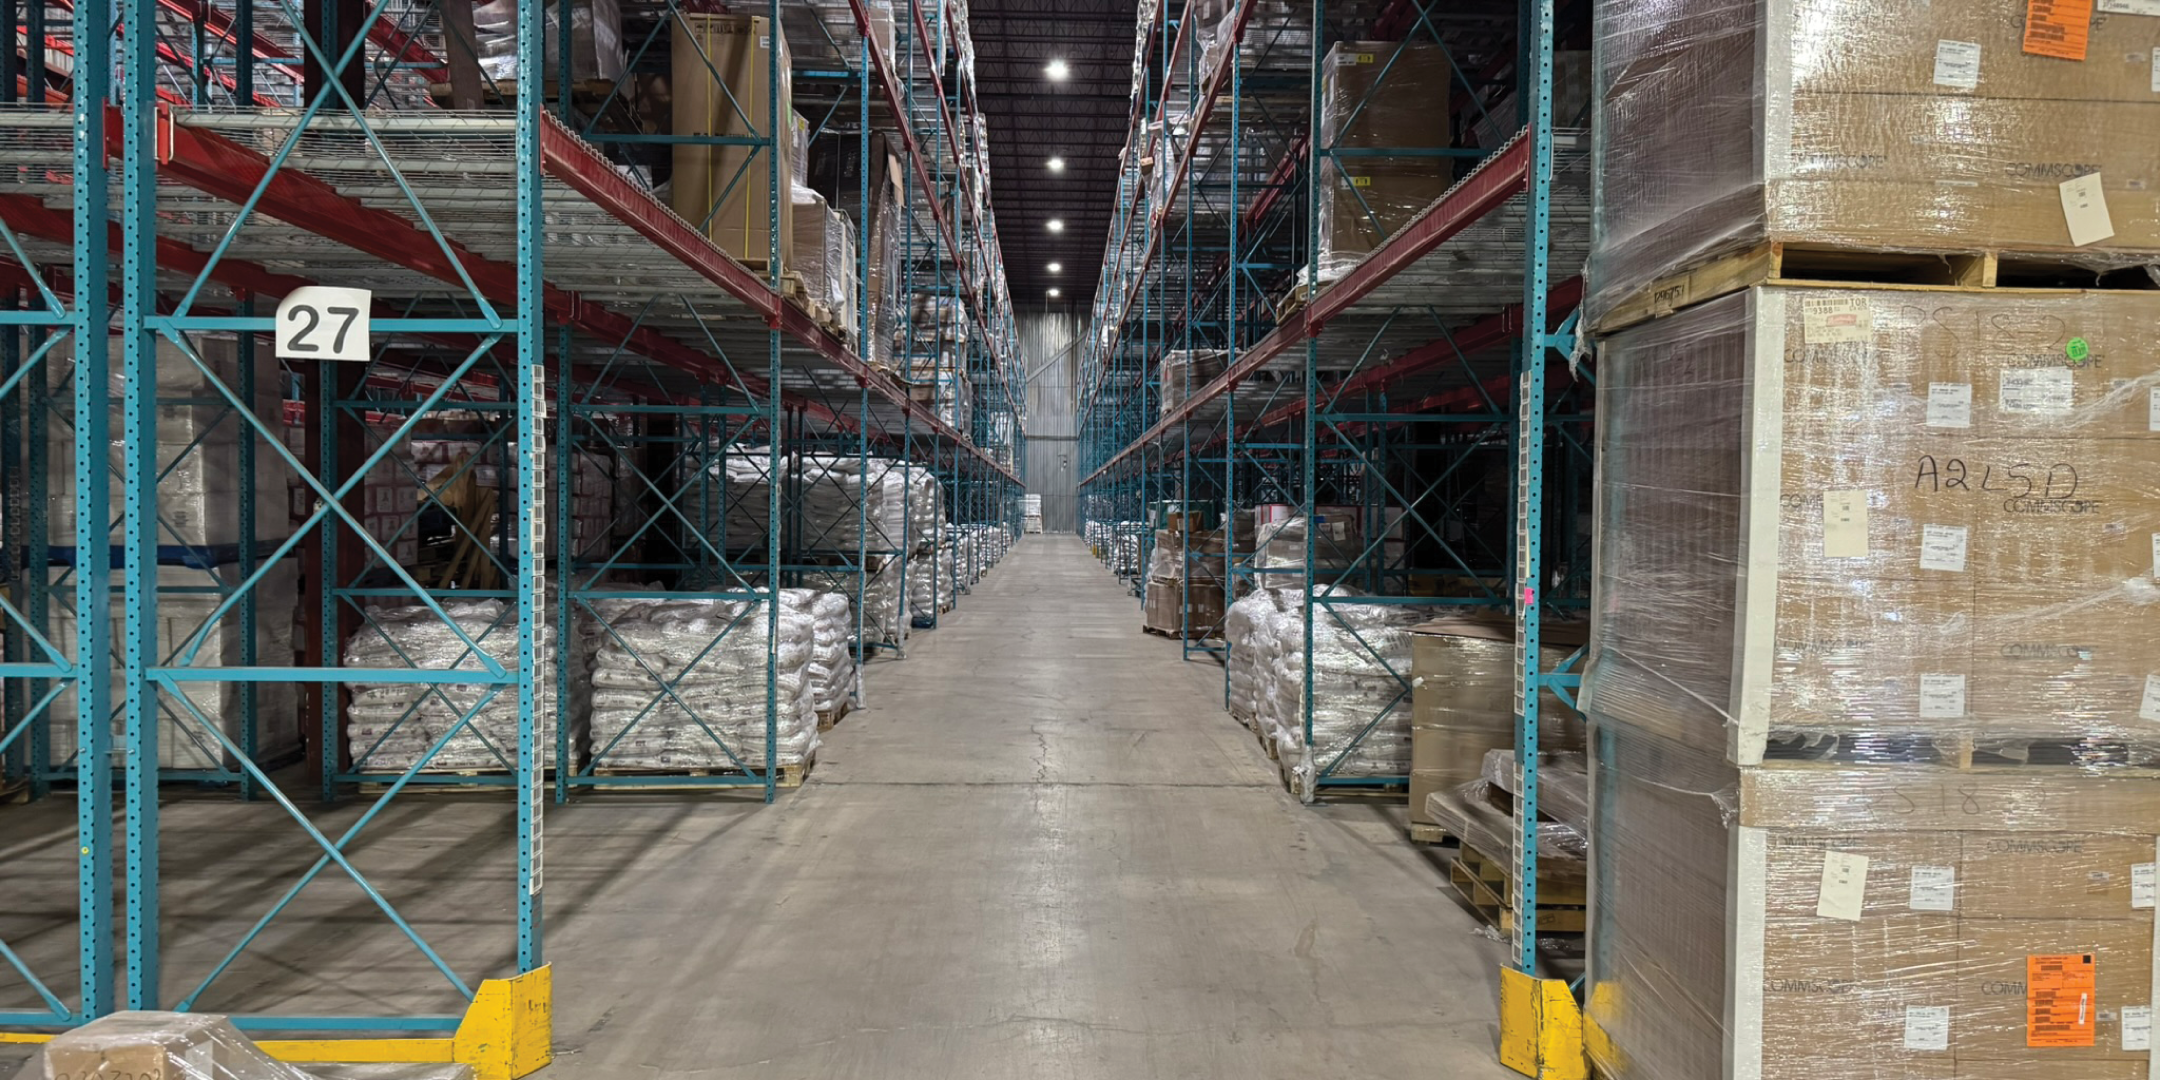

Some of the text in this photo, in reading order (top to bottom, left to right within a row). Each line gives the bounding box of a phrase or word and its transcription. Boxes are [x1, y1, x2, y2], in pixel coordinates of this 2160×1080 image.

[1796, 154, 1885, 169] MMSCOPE
[286, 304, 360, 355] 27
[2003, 499, 2100, 514] COMMSCOPE
